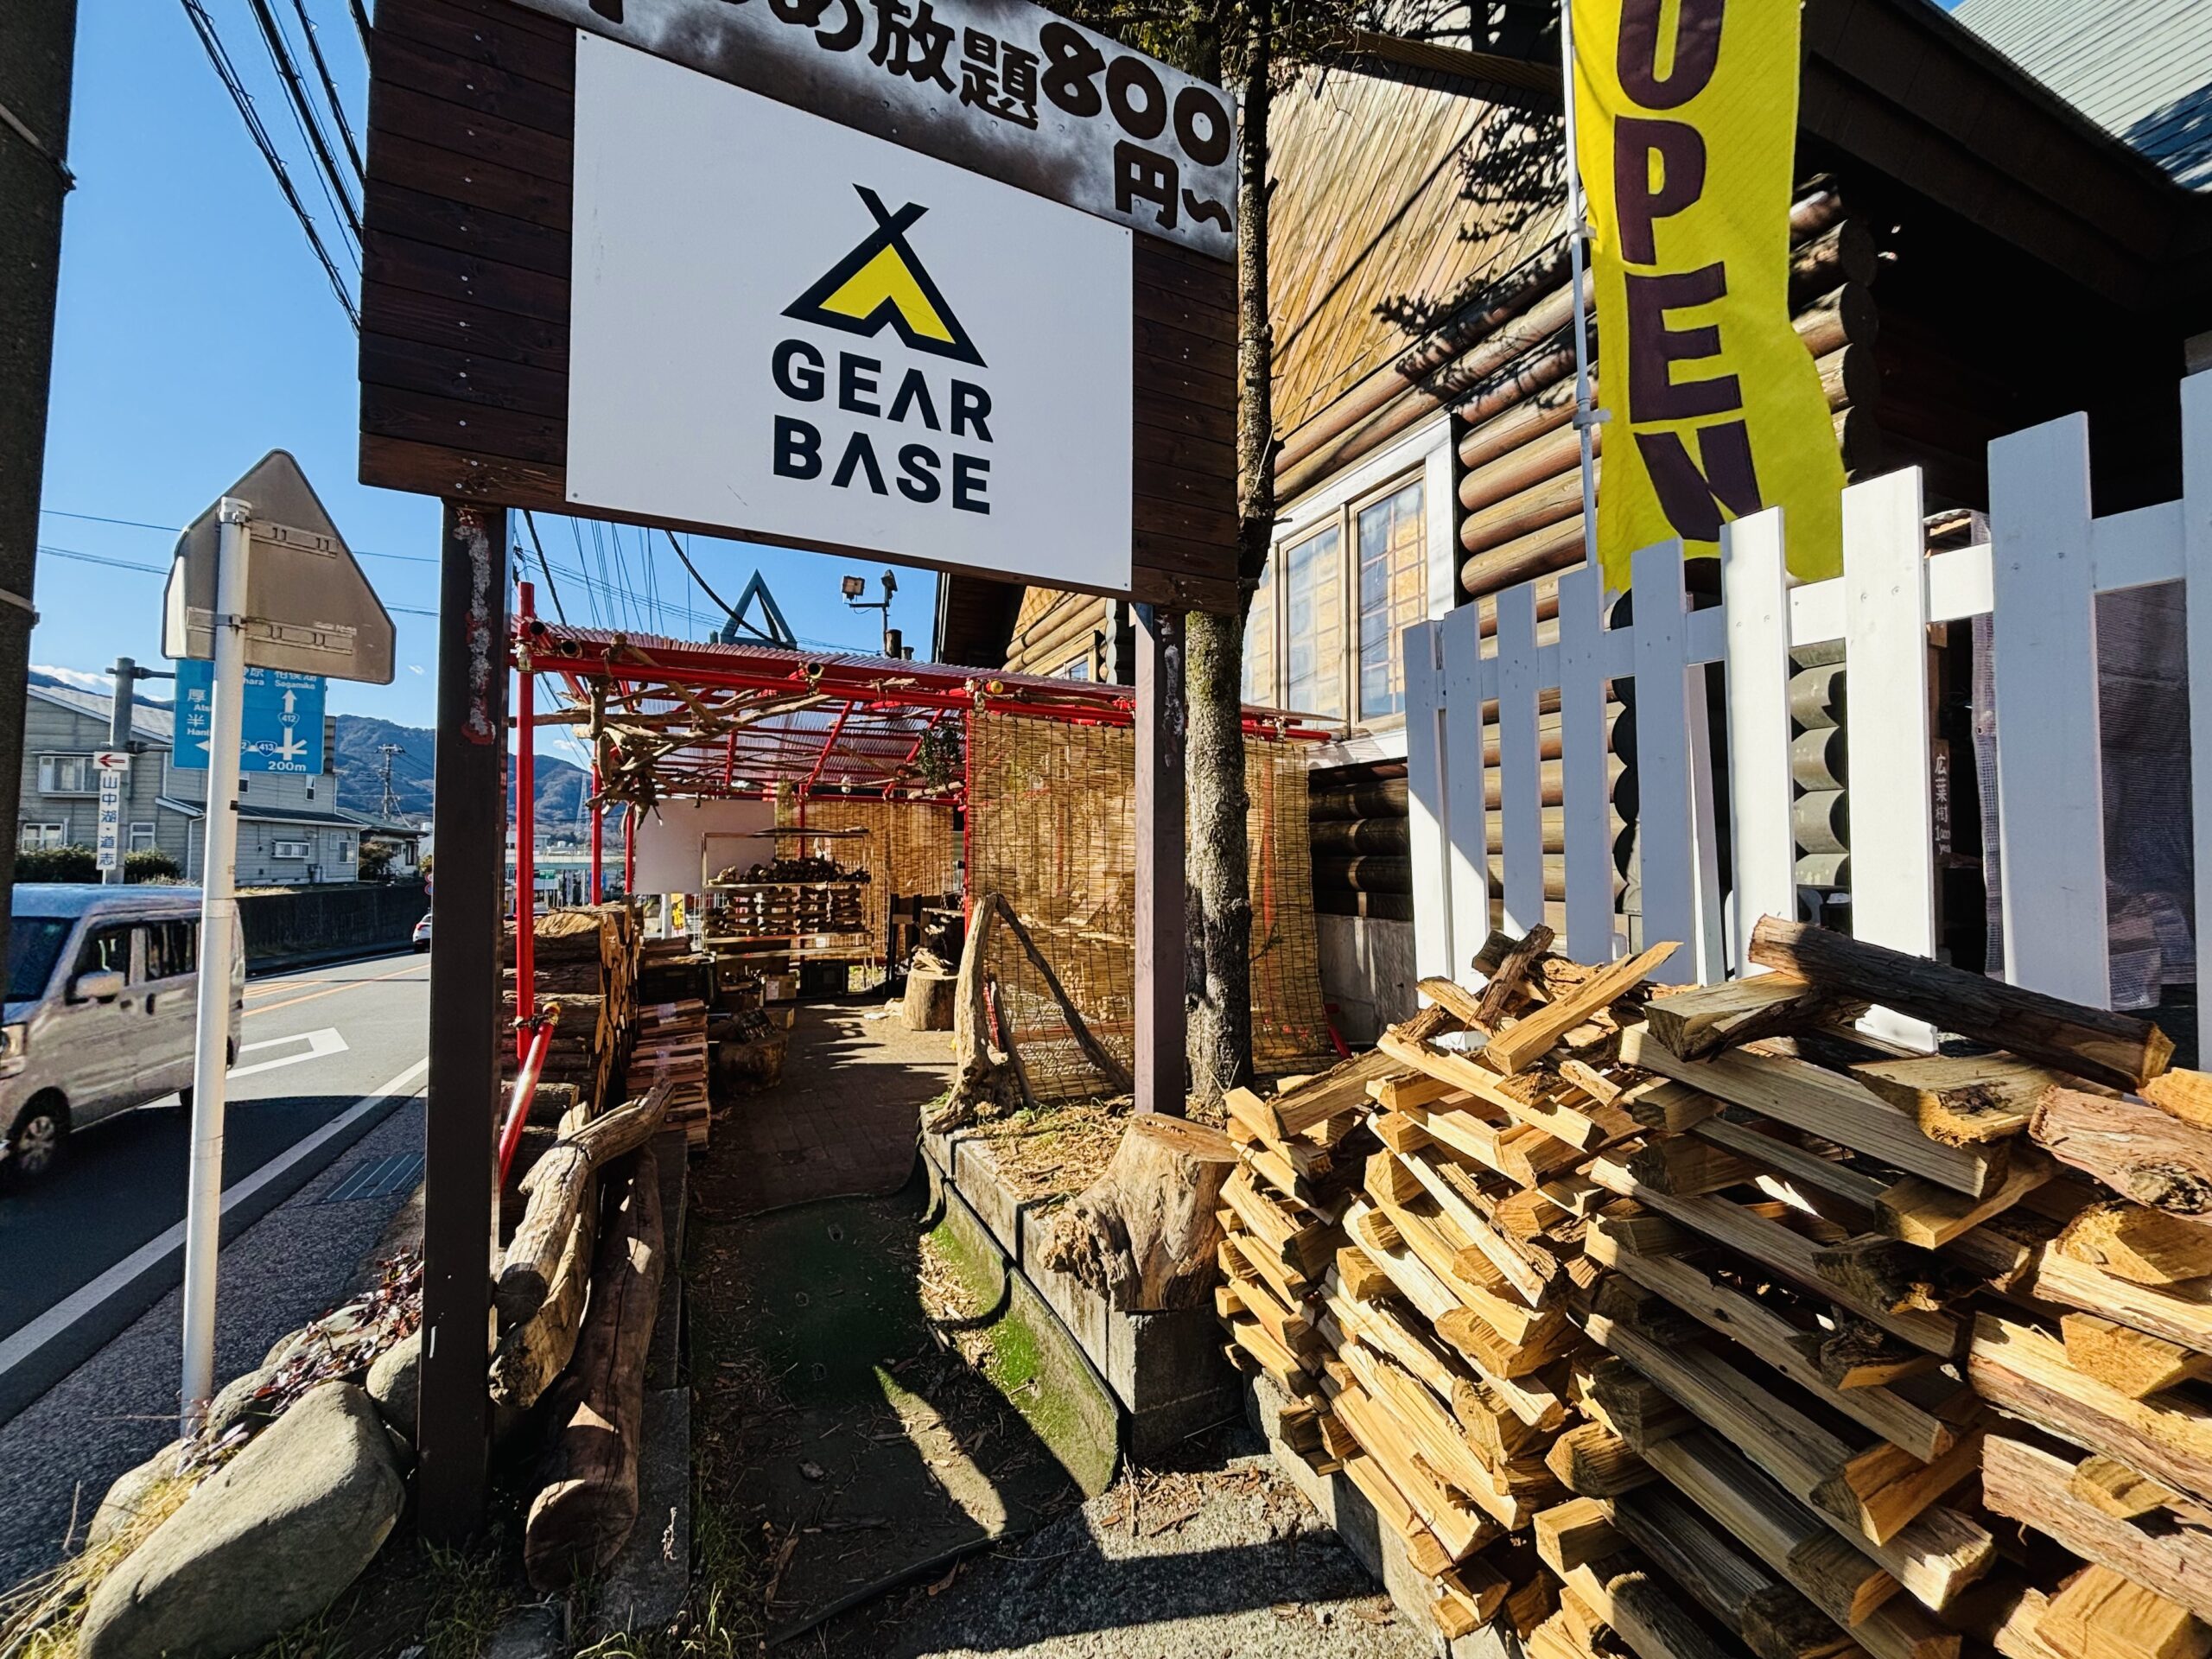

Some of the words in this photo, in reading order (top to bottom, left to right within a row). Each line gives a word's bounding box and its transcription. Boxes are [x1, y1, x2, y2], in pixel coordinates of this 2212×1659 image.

[772, 339, 994, 443] GEAR
[773, 414, 990, 515] BASE
[187, 689, 207, 702] 厚
[187, 713, 206, 728] 半
[281, 715, 296, 723] 412
[258, 742, 274, 752] 413
[268, 760, 307, 772] 200m
